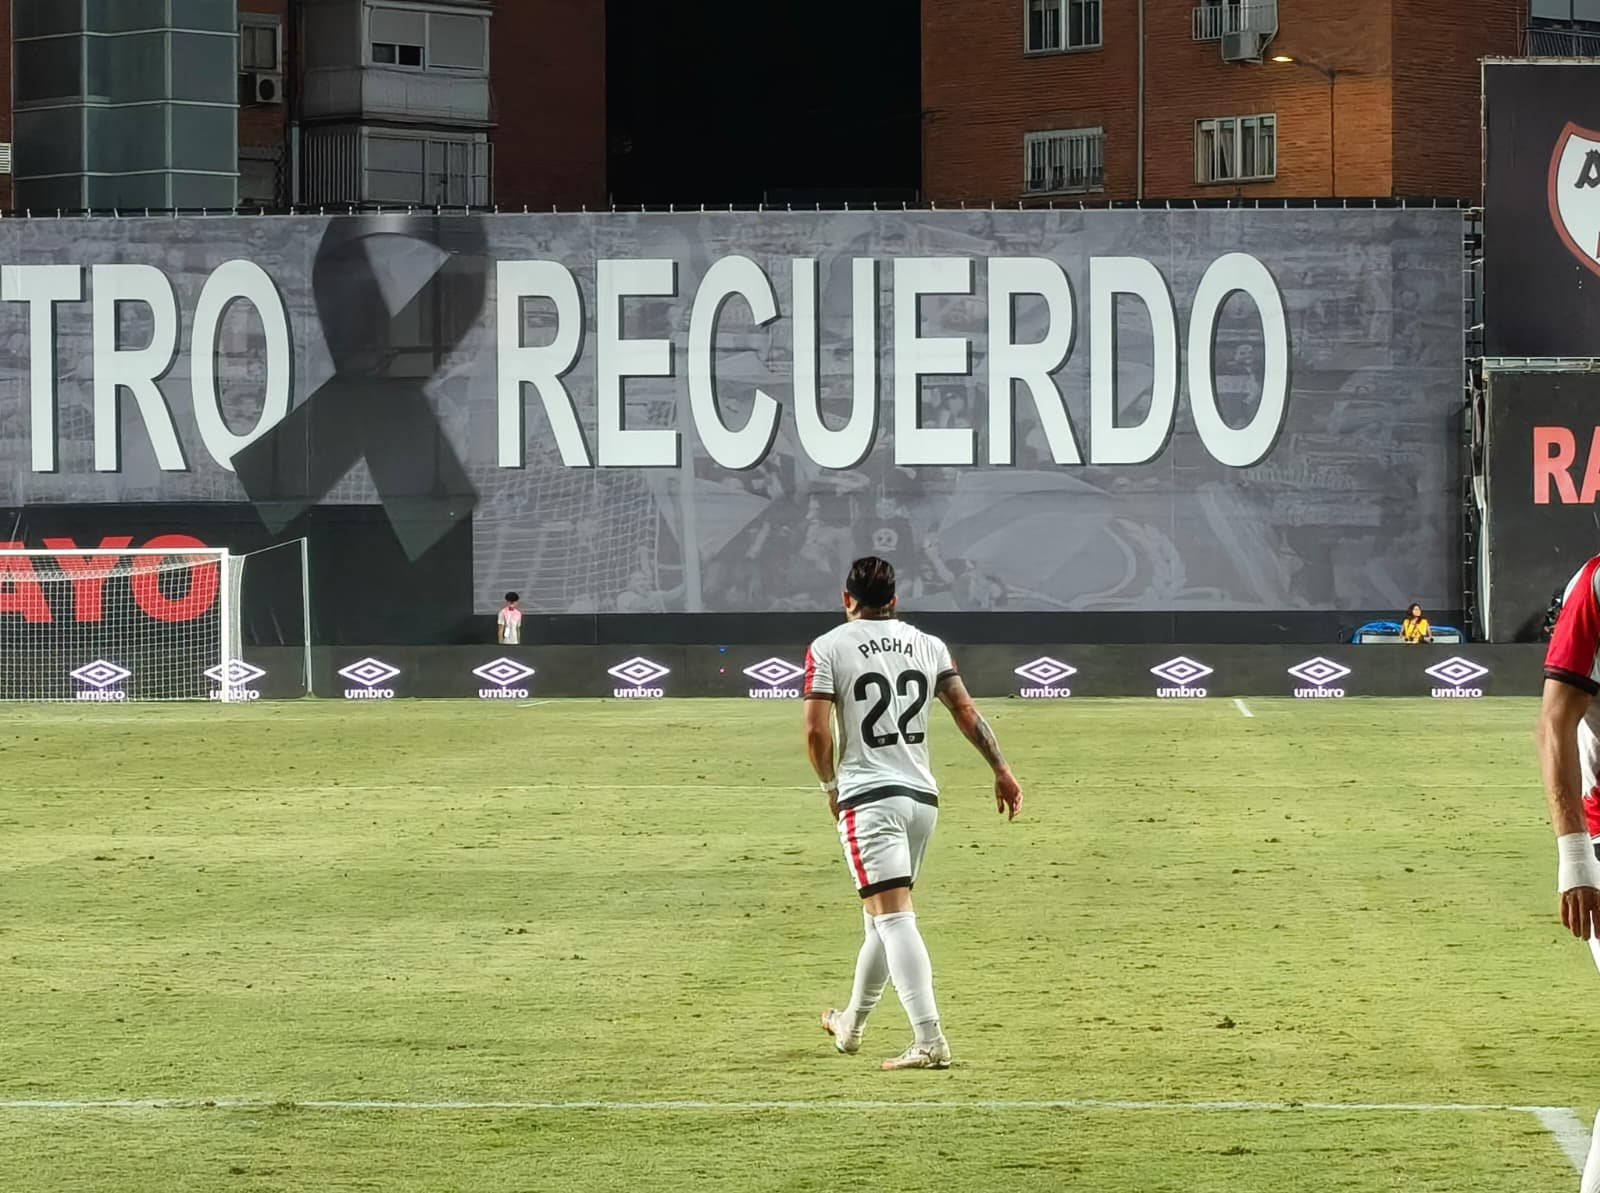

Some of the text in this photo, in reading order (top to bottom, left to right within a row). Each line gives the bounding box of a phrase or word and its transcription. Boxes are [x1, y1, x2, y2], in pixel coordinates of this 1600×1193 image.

[1, 252, 1291, 473] TRO RECUERDO
[858, 637, 914, 659] PACHA
[76, 688, 126, 700] umbro
[344, 686, 394, 698] umbro
[478, 686, 528, 698] umbro
[613, 686, 664, 698] umbro
[749, 686, 800, 698] umbro
[1020, 686, 1071, 698] umbro
[1156, 686, 1207, 698] umbro
[1294, 686, 1345, 698] umbro
[1431, 686, 1482, 698] umbro
[853, 669, 928, 748] 22
